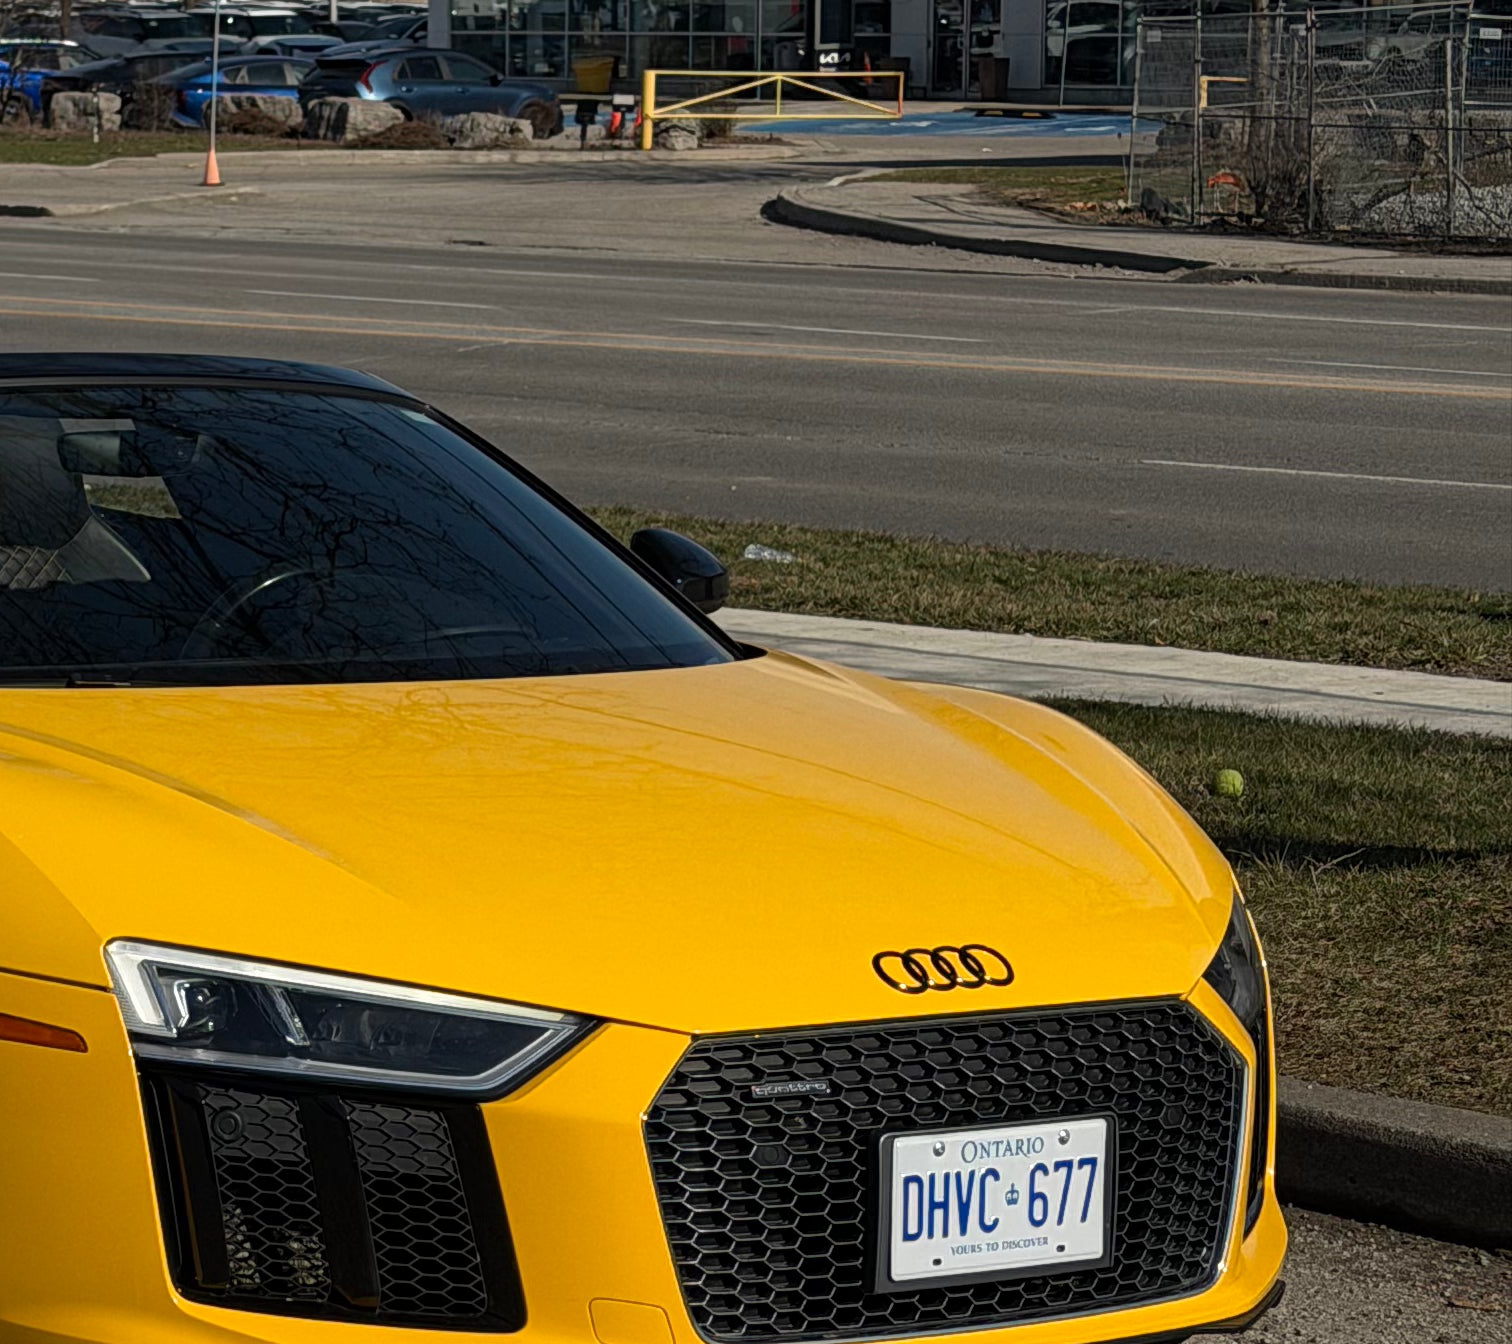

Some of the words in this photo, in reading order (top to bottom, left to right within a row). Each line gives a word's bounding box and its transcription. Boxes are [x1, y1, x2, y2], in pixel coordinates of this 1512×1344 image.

[754, 1083, 827, 1096] quattro
[960, 1136, 1045, 1164] ONTARIO
[902, 1167, 1001, 1242] DHVC
[1028, 1156, 1098, 1228] 677
[950, 1243, 983, 1256] YOURS
[986, 1241, 999, 1252] TO
[1001, 1236, 1049, 1251] DISCOVER
